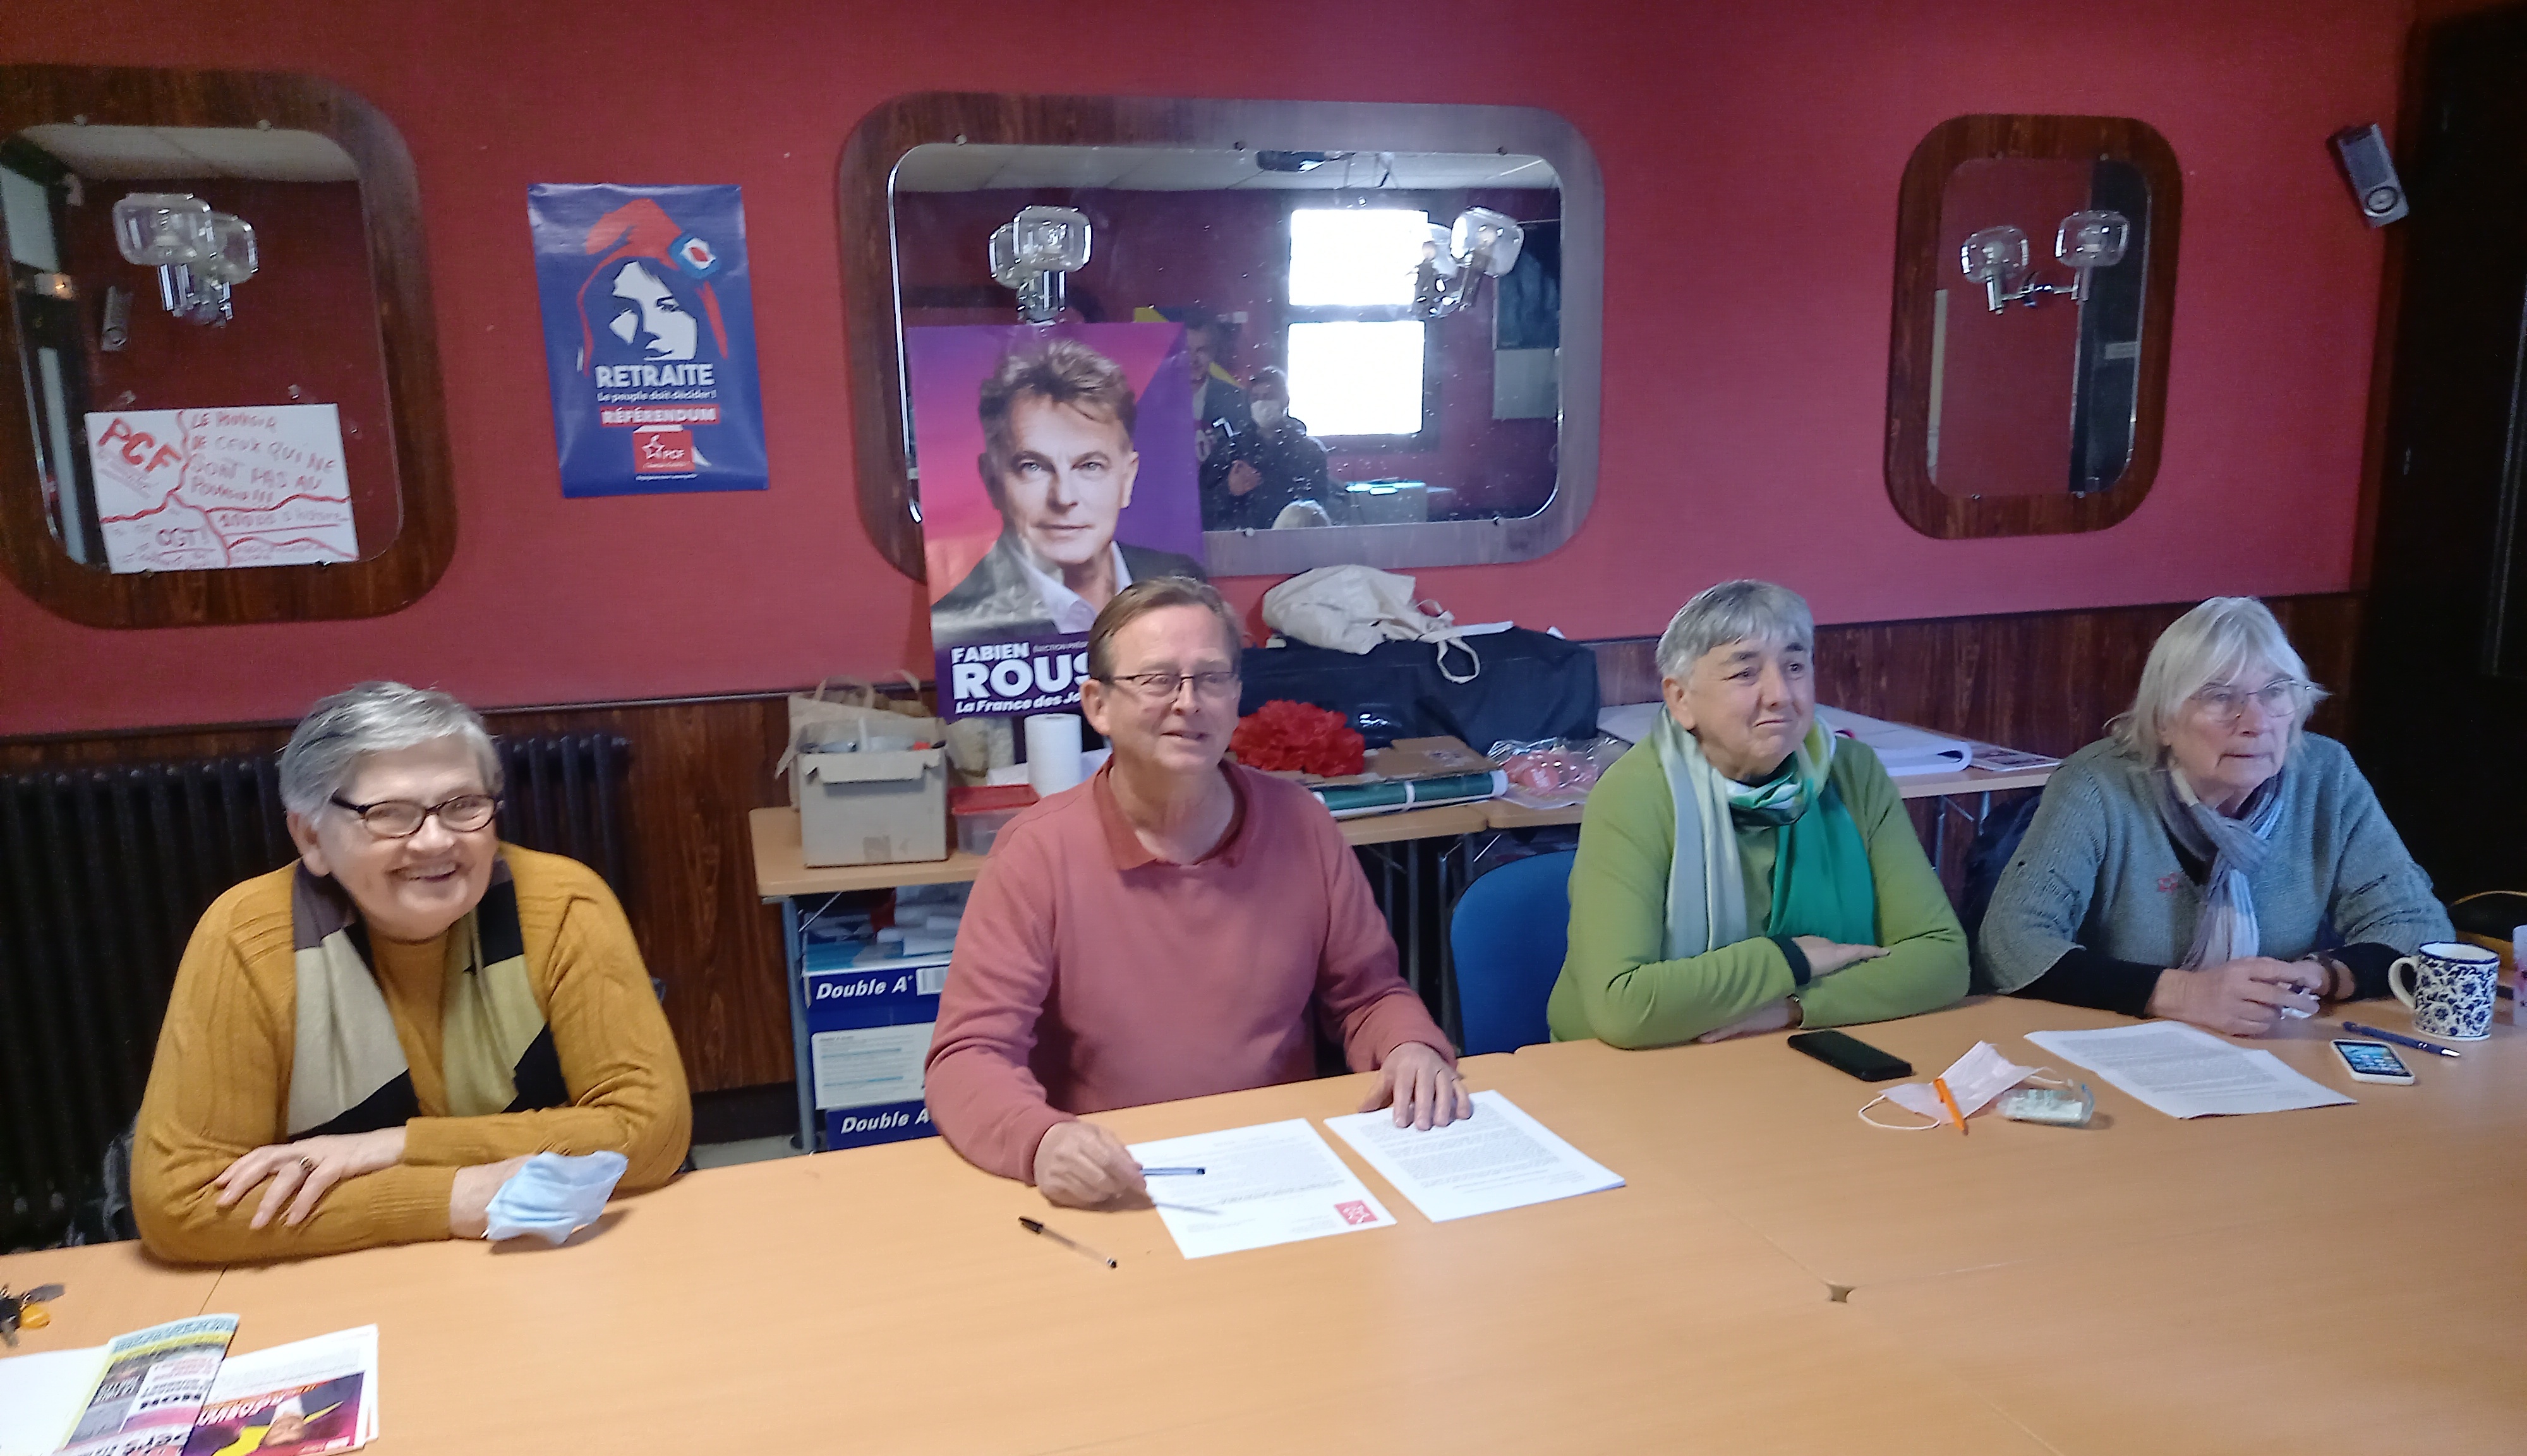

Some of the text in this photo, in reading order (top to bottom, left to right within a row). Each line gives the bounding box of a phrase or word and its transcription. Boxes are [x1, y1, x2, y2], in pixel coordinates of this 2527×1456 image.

[595, 363, 715, 388] RETRAITE
[596, 392, 611, 402] Le
[611, 390, 649, 403] peuple
[191, 412, 210, 429] LE
[601, 406, 717, 424] RÉFÉRENDUM
[99, 418, 181, 471] PCF
[268, 442, 303, 462] QUI
[306, 452, 335, 472] NE
[295, 475, 322, 491] AU
[951, 642, 1030, 663] FABIEN
[955, 701, 975, 714] La
[975, 698, 1033, 713] France
[1033, 694, 1063, 709] des
[816, 978, 887, 1000] Double
[840, 1107, 931, 1134] Double A
